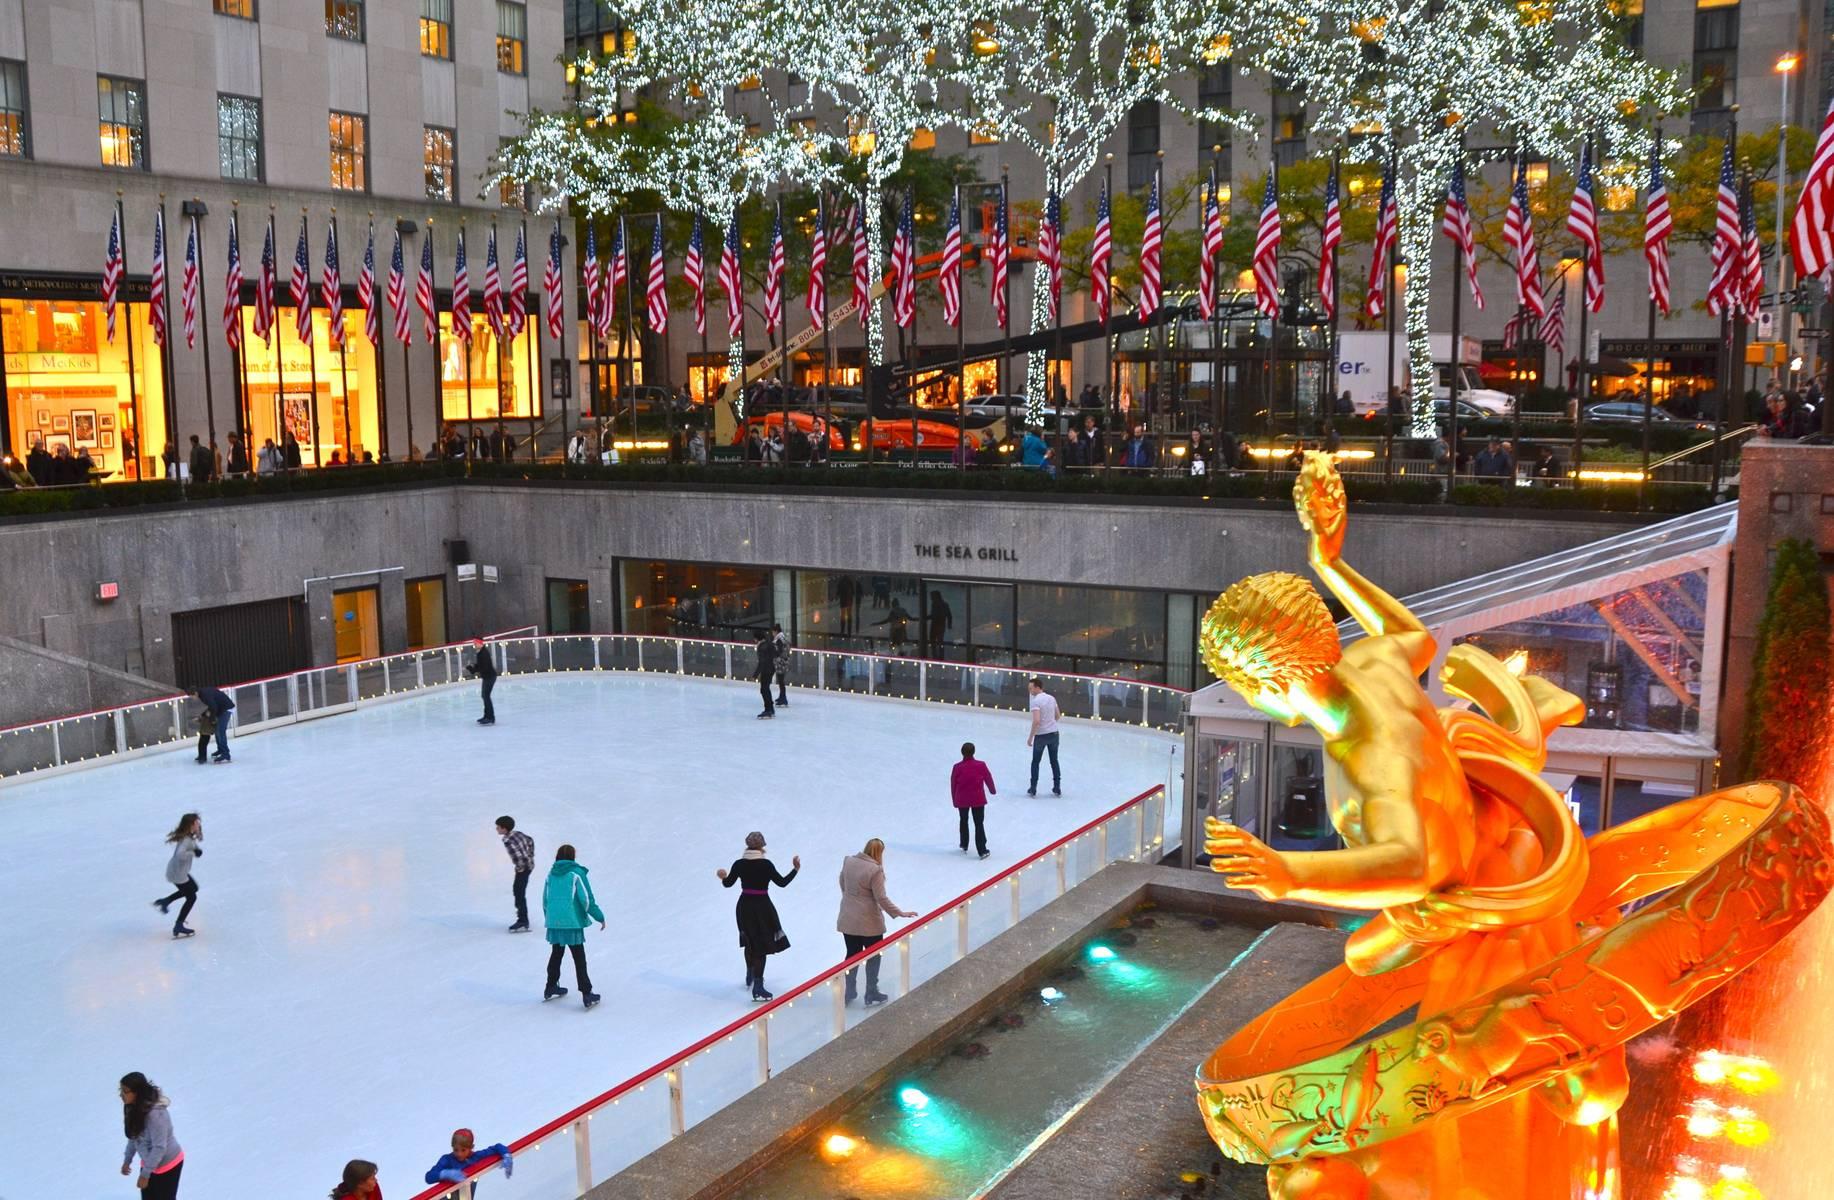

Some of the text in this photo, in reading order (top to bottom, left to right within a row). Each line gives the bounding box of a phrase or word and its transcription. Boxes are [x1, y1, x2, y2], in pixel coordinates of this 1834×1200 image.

[914, 544, 1019, 562] THE SEA GRILL
